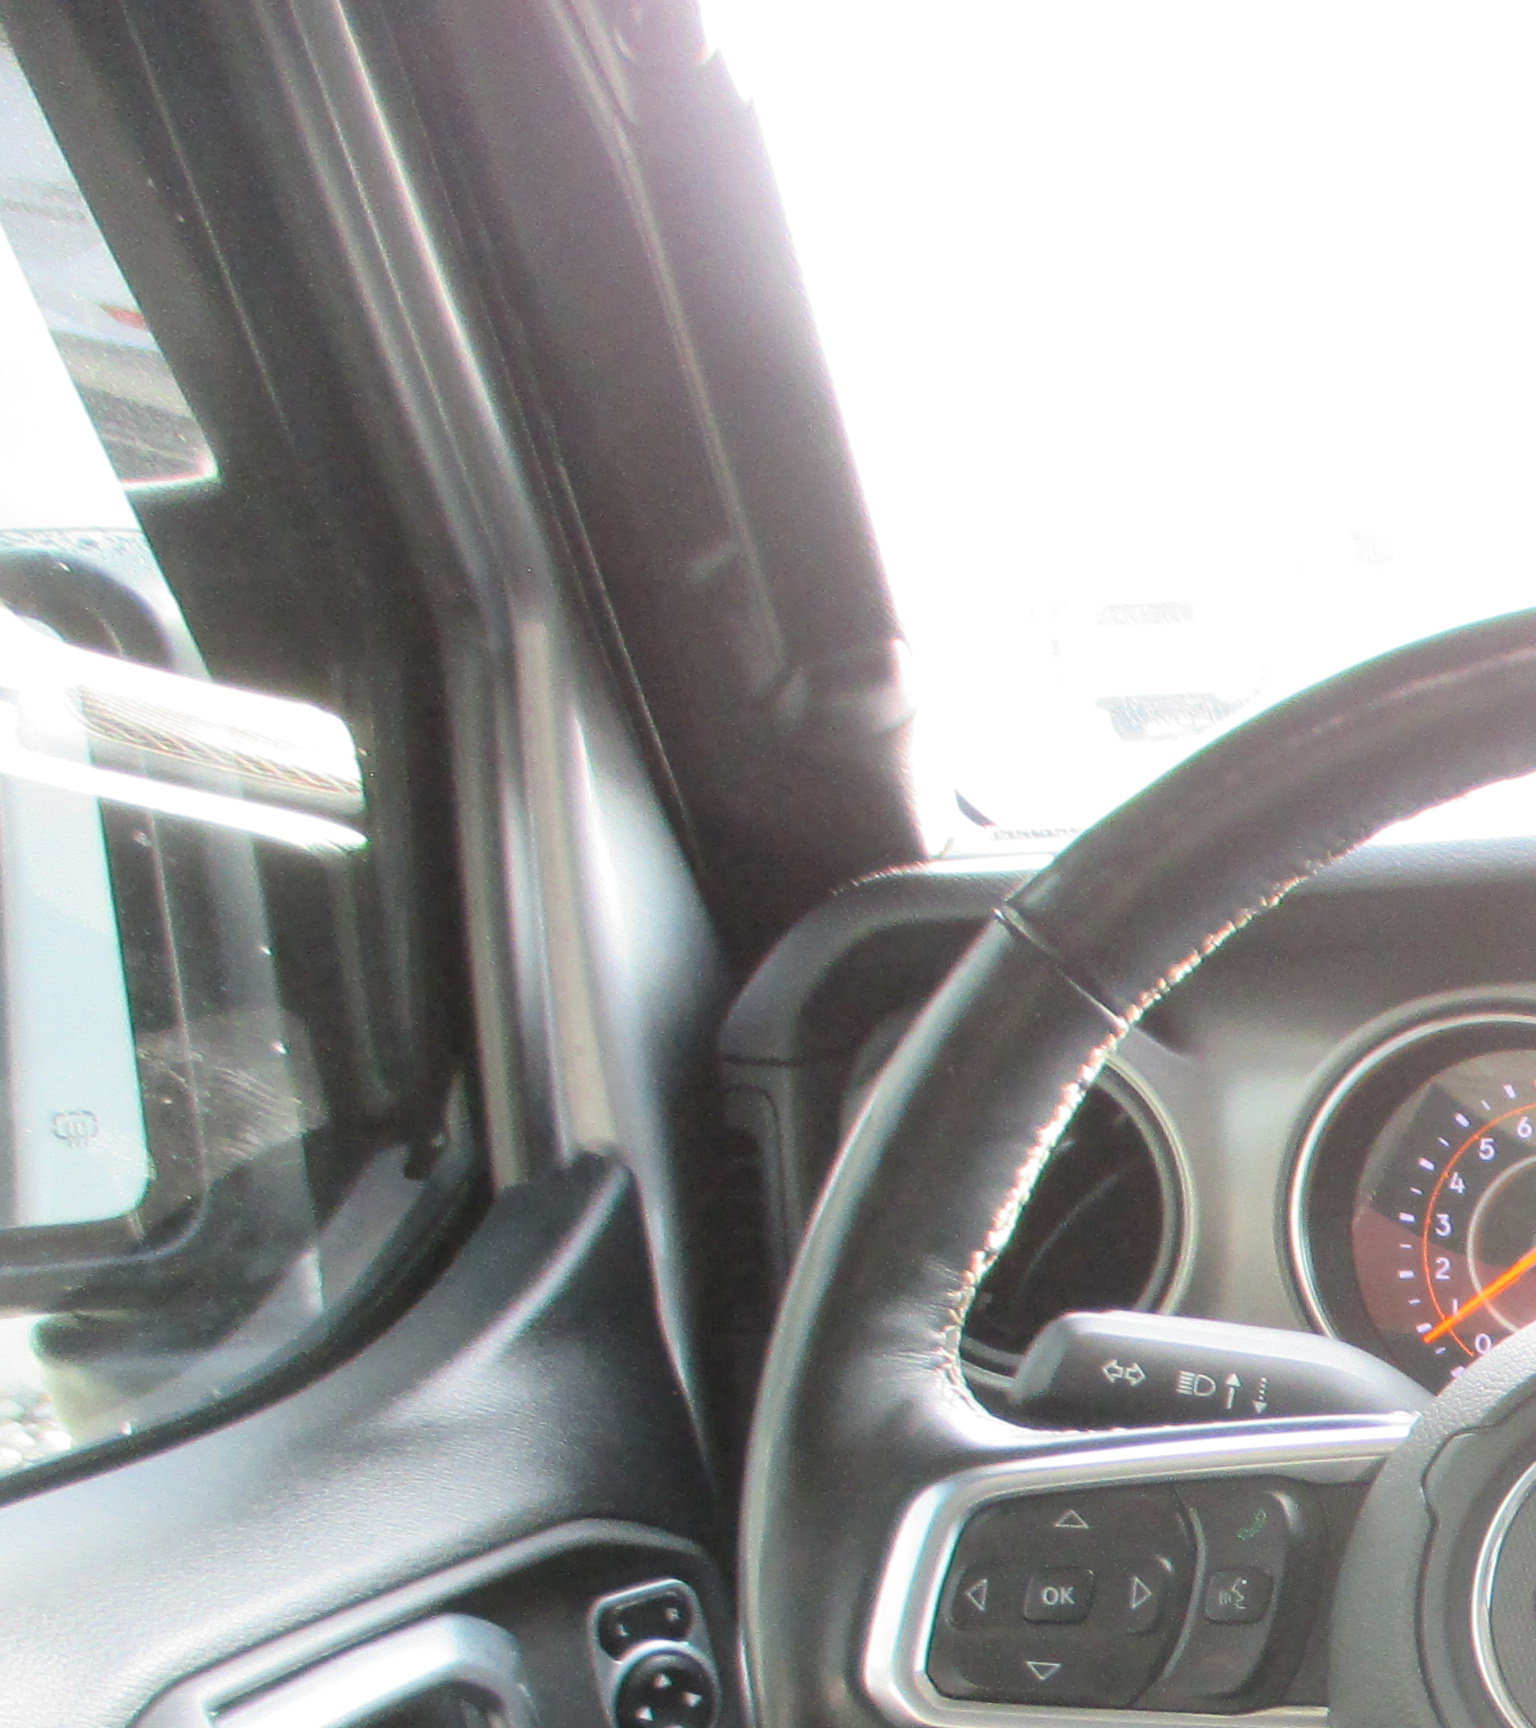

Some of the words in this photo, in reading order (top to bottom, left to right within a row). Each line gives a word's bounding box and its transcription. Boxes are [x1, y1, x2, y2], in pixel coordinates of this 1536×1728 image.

[1516, 1119, 1532, 1138] 6
[1479, 1137, 1495, 1161] 5
[1449, 1172, 1466, 1195] 4
[1435, 1213, 1452, 1238] 3
[1435, 1256, 1451, 1280] 2
[1474, 1334, 1493, 1354] 0
[1042, 1587, 1075, 1605] OK
